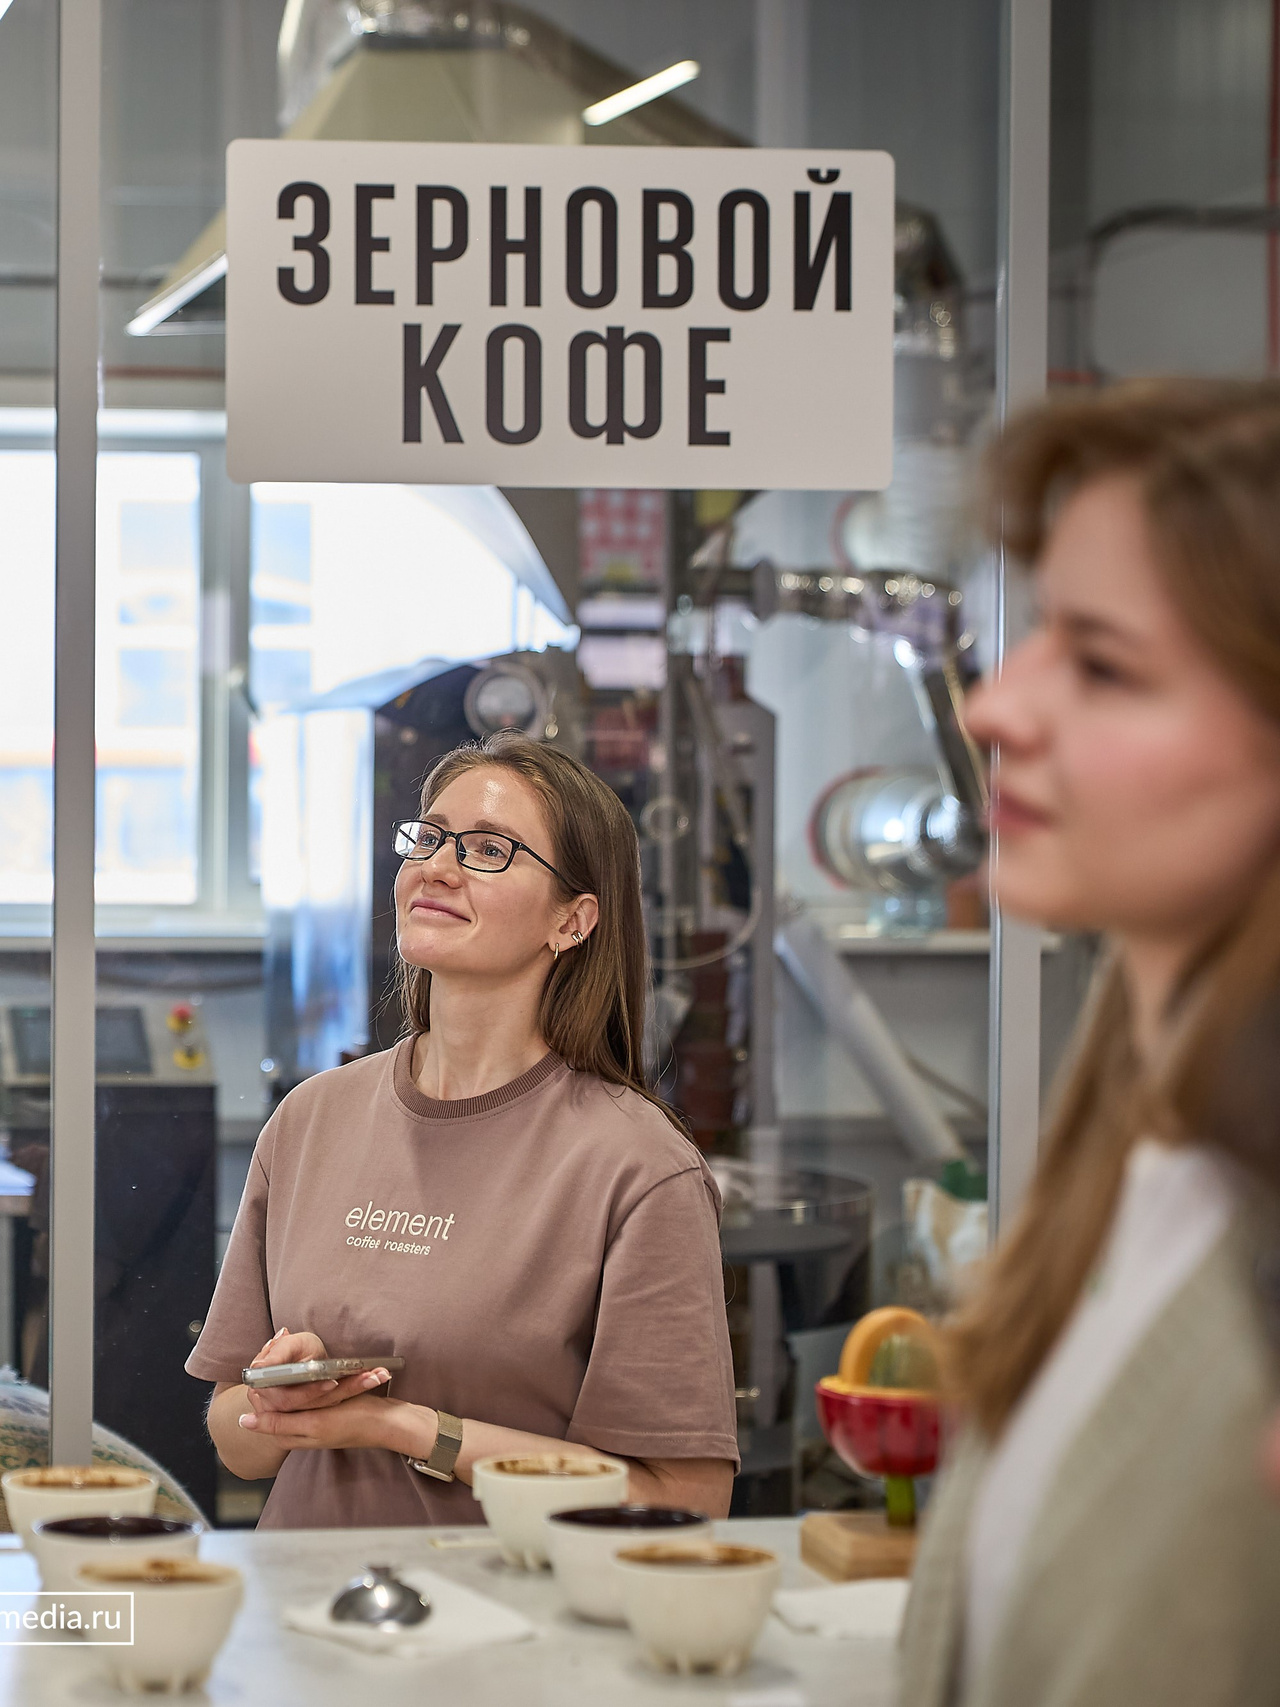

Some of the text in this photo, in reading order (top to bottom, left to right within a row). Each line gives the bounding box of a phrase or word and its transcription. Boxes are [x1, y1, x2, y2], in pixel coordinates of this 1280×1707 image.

[277, 168, 853, 312] ЗЕРНОВОЙ
[402, 323, 732, 447] КОФЕ
[344, 1200, 455, 1241] element
[346, 1236, 432, 1256] coffee roasters
